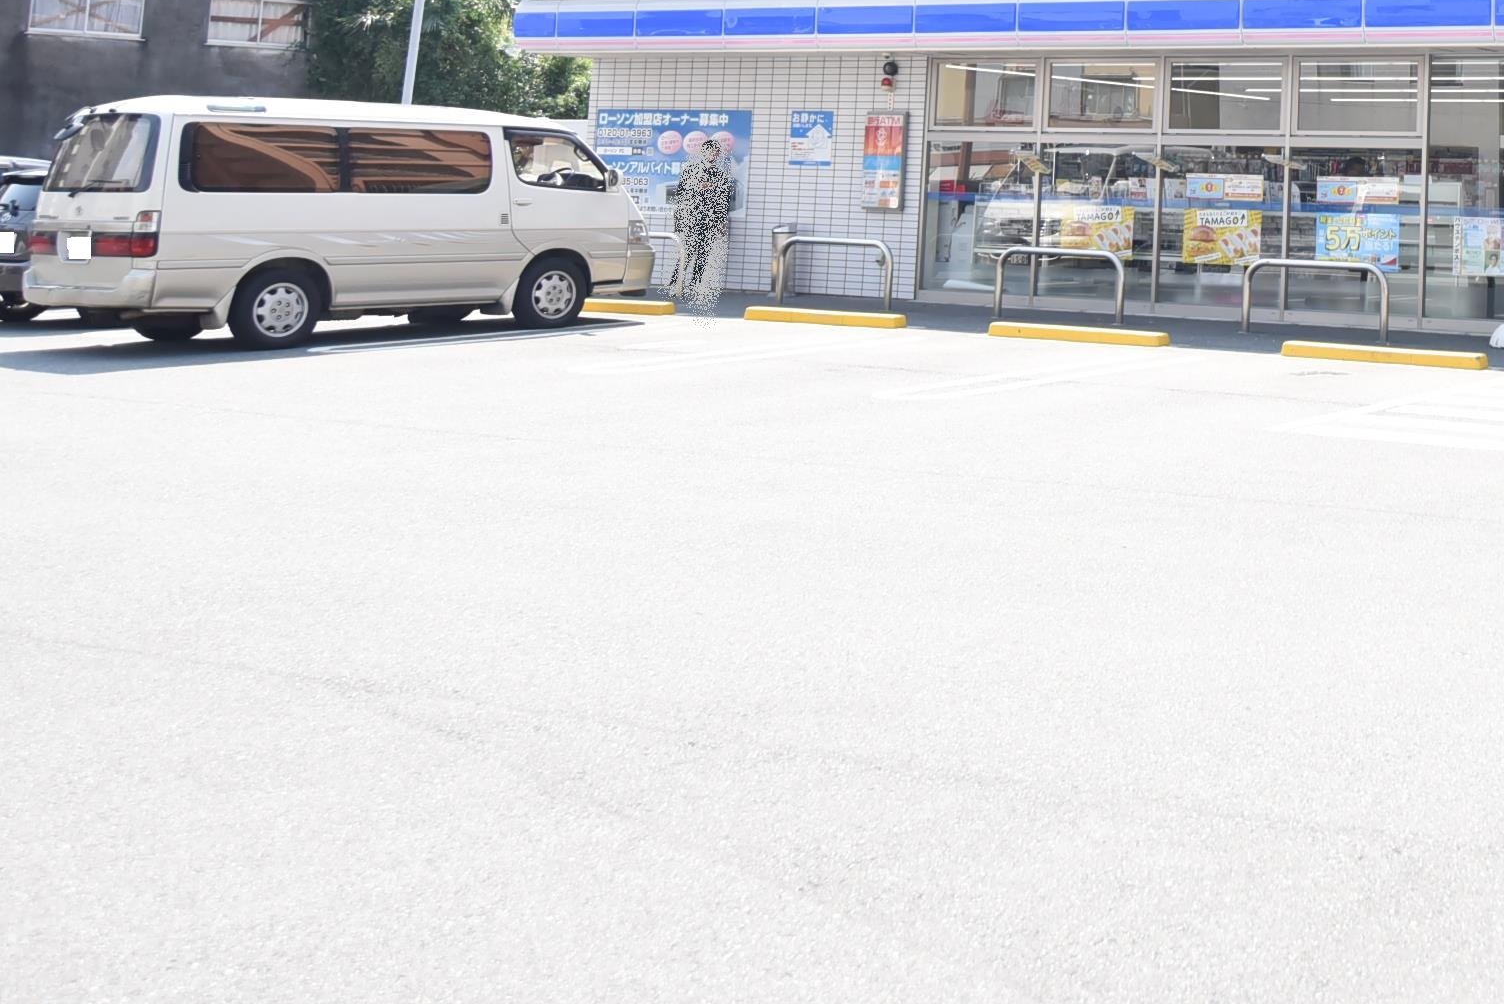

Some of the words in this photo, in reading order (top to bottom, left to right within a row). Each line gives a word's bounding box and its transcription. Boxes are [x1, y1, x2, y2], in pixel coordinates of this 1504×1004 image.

[599, 112, 729, 127] ローソン加盟店オーナー募集中
[792, 112, 825, 124] お静かに
[606, 160, 687, 175] ーソンアルバイト募
[1200, 216, 1239, 225] TAMAGO
